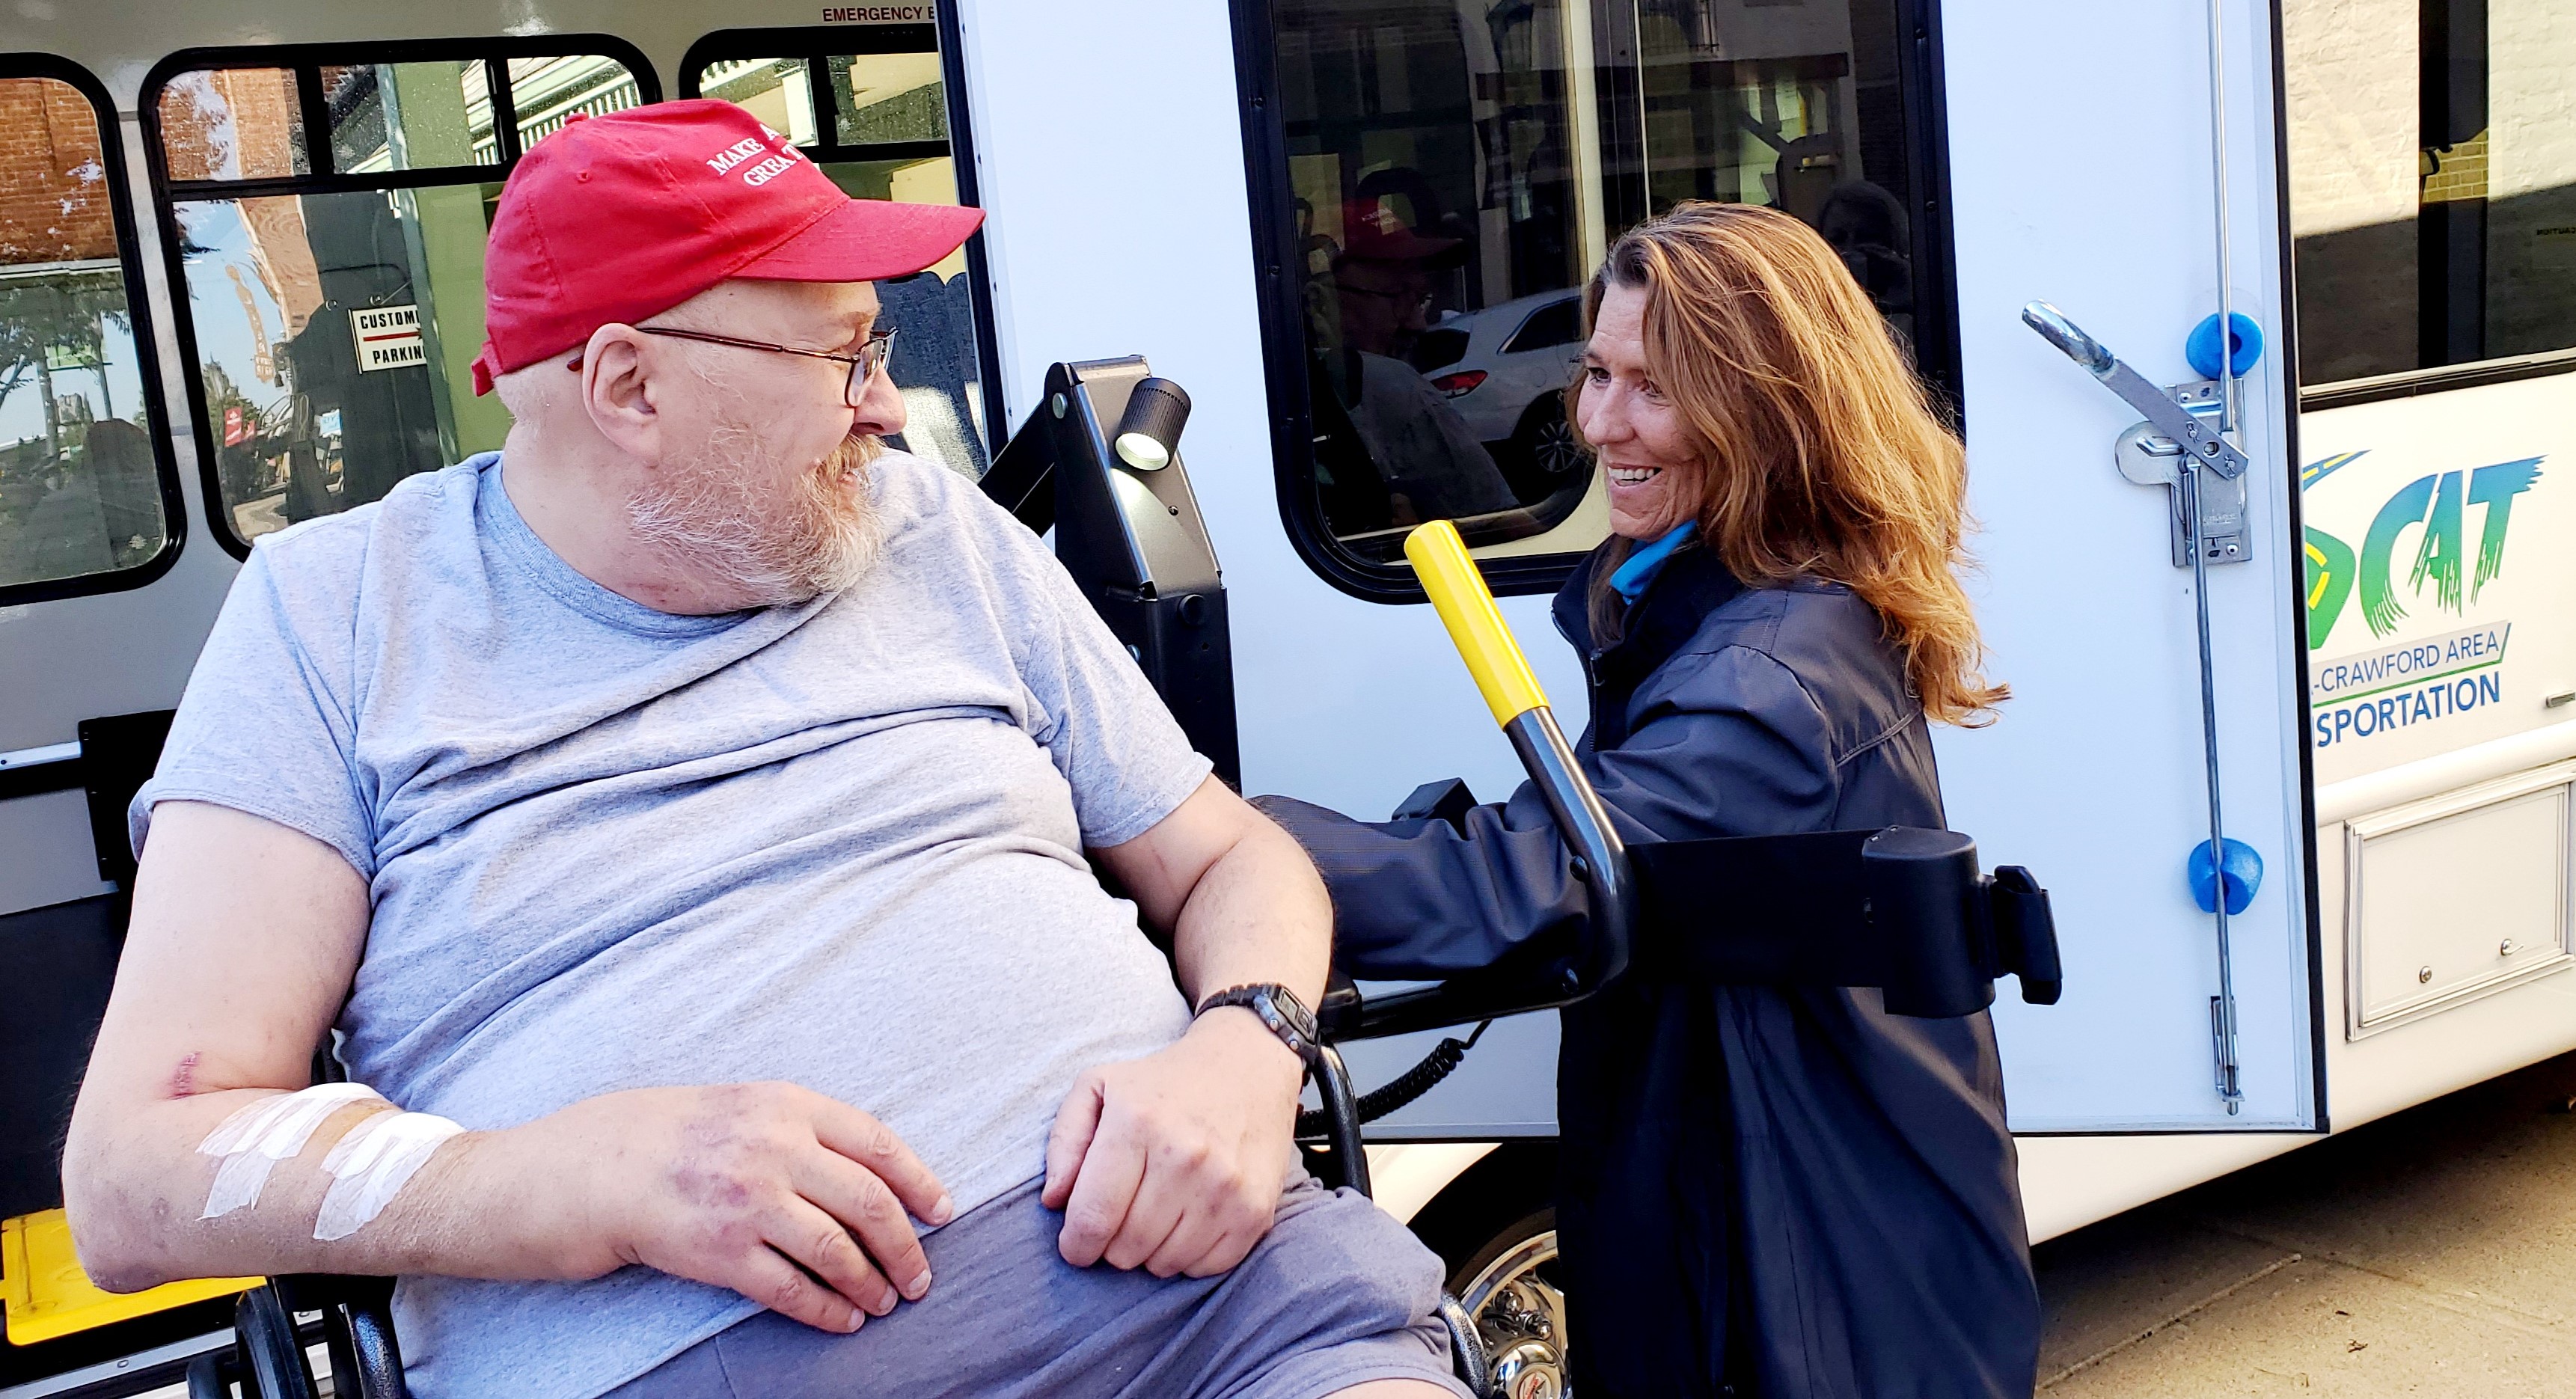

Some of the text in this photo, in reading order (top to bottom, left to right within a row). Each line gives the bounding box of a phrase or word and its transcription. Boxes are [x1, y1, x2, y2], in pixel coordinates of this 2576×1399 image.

[823, 6, 923, 22] EMERGENCY
[706, 138, 765, 176] MAKE
[743, 144, 805, 186] GREAT
[373, 346, 426, 364] PARKIN
[2310, 631, 2500, 696] -CRAWFORD AREA
[2313, 672, 2500, 749] SPORTATION
